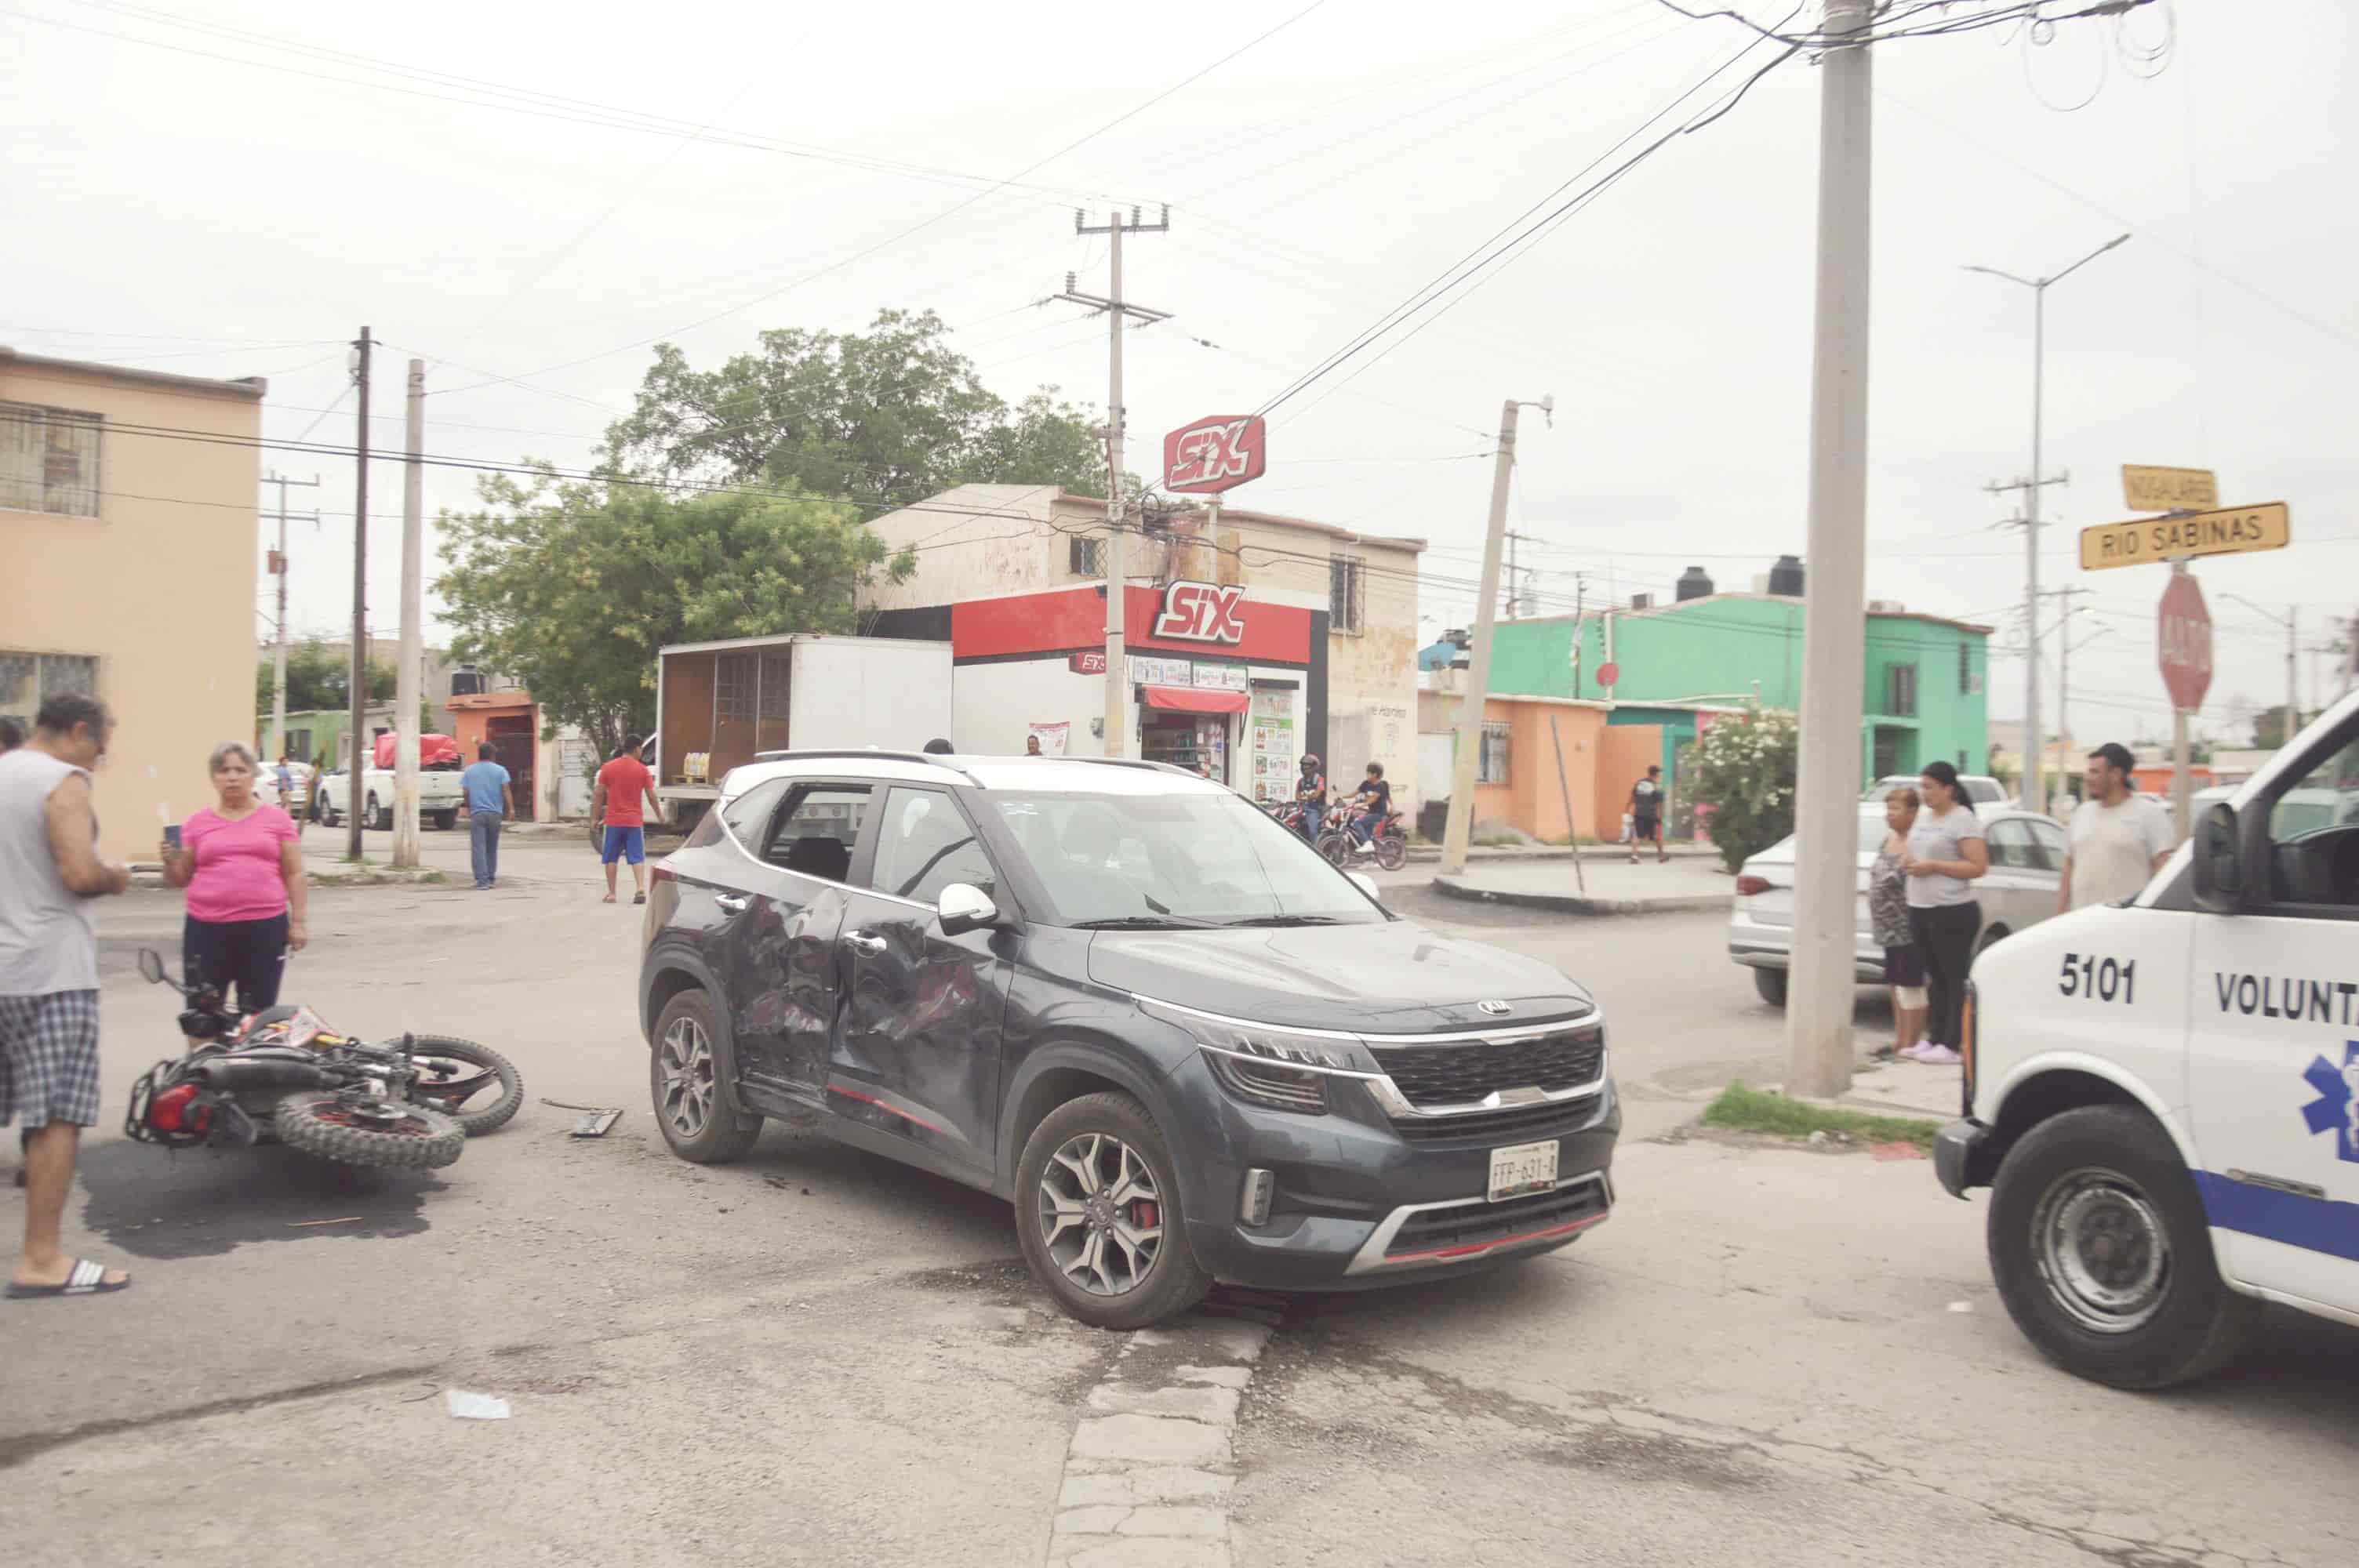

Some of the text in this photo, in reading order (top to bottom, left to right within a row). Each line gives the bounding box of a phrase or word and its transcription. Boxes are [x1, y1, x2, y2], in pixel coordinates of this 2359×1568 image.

[2101, 515, 2262, 557] RIO SABINAS
[2059, 953, 2136, 1005] 5101
[2215, 972, 2359, 1027] VOLUNT
[1481, 1000, 1511, 1014] KIA
